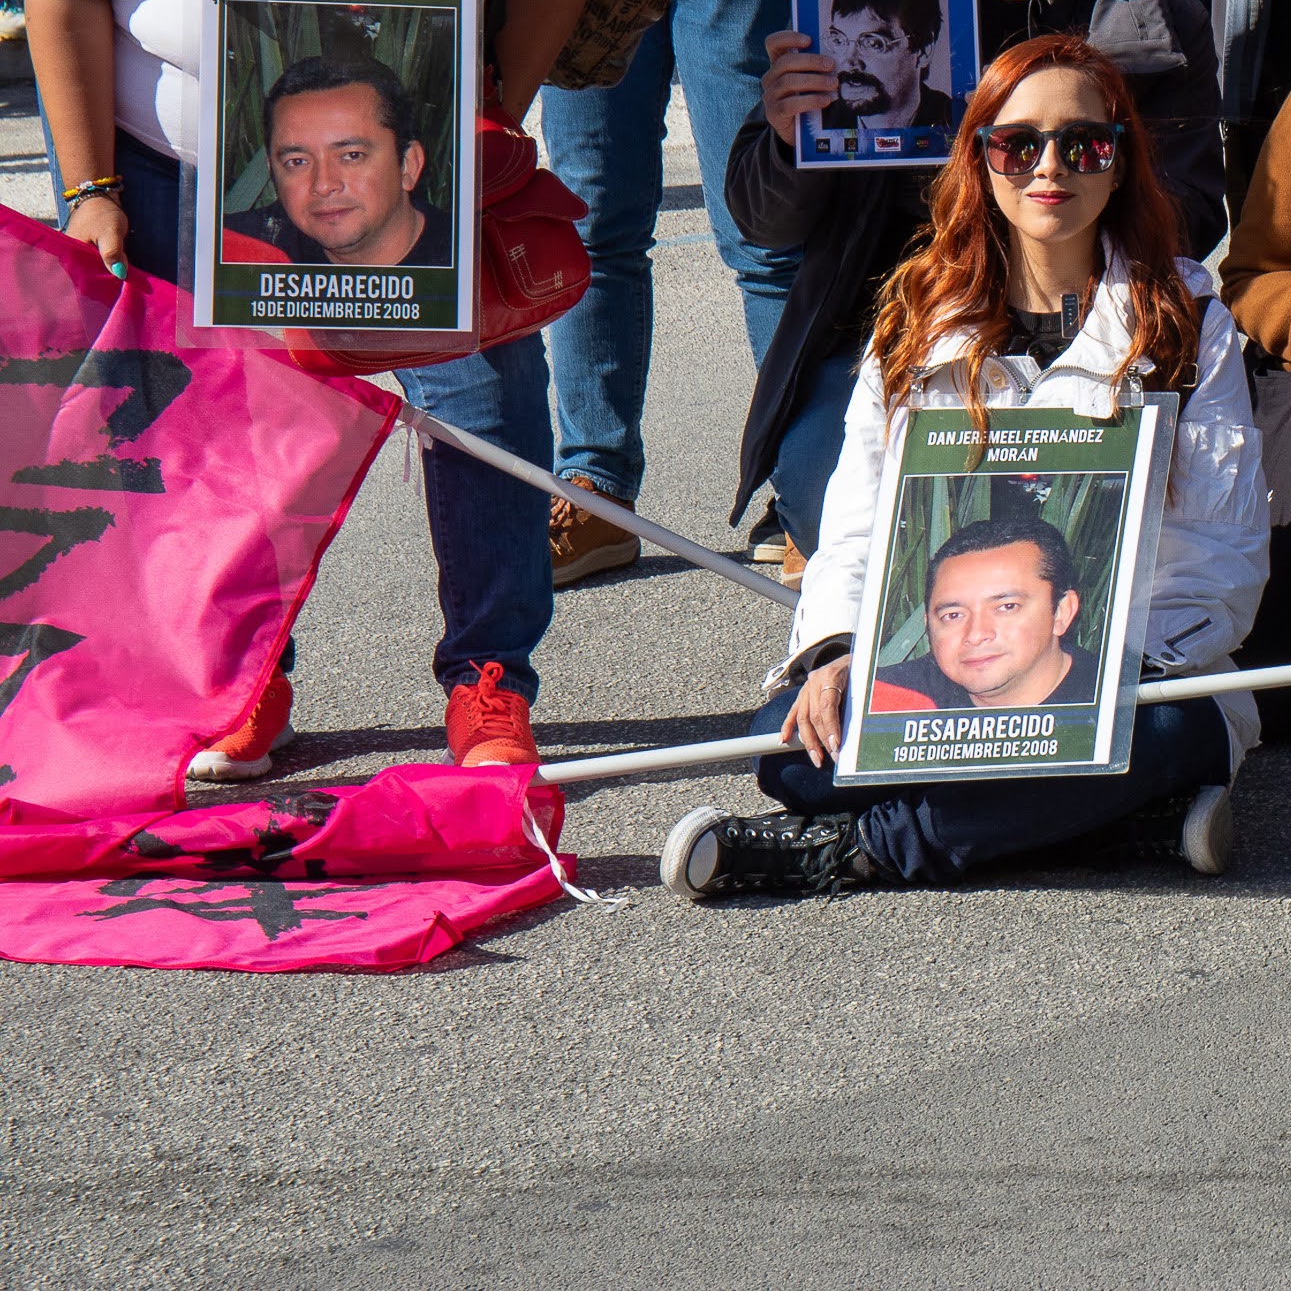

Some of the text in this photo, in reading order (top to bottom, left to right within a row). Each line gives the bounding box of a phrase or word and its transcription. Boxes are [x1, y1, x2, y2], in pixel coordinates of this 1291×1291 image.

[260, 273, 414, 299] DESAPARECIDO
[251, 301, 420, 320] 19 DE DICIEMBRE DE 2008
[927, 430, 955, 446] DAN
[1023, 428, 1103, 445] FERNÁNDEZ
[987, 446, 1038, 463] MORÁN
[903, 713, 1055, 743] DESAPARECIDO
[893, 740, 1058, 763] 19 DE DICIEMBRE DE 2008
